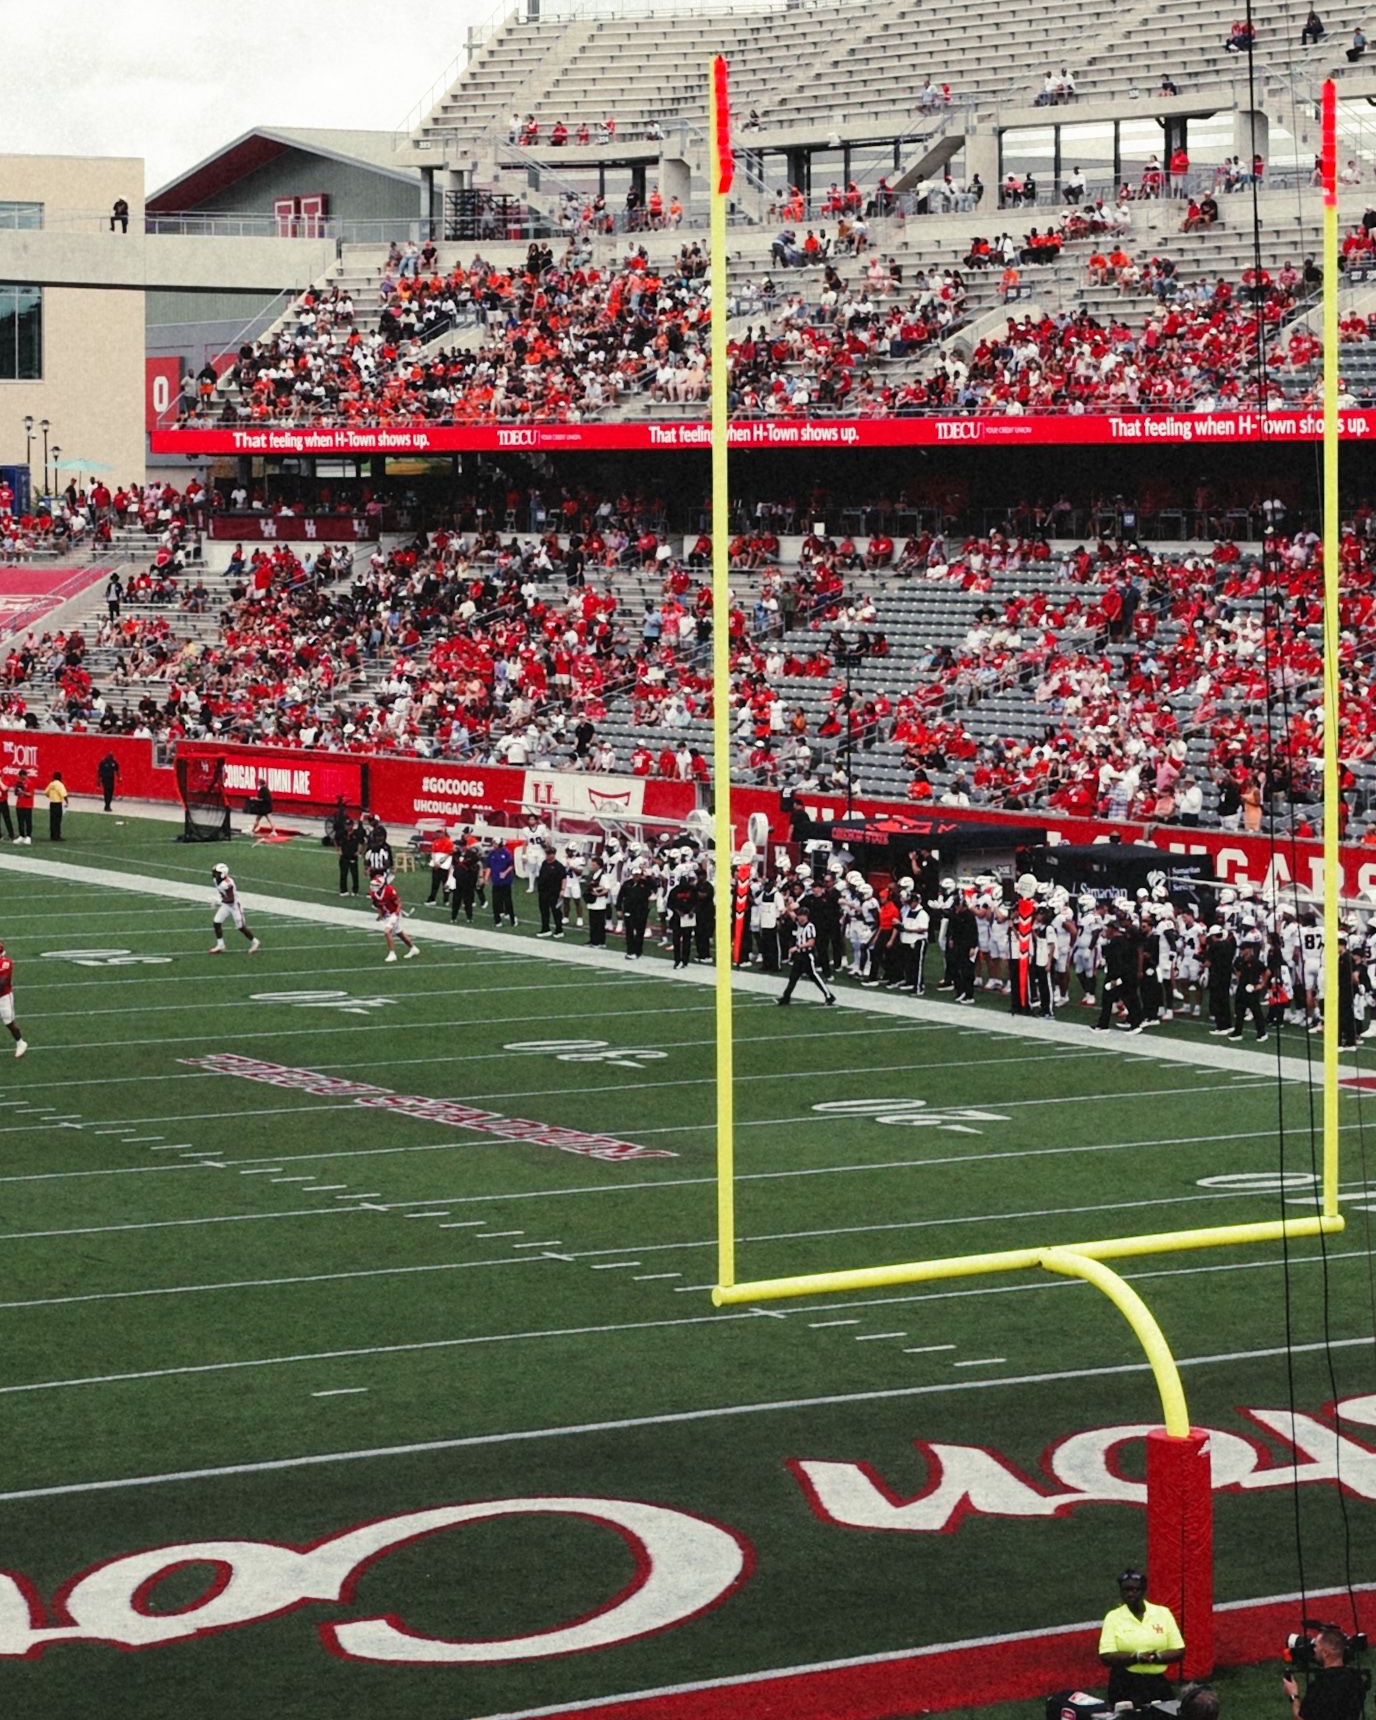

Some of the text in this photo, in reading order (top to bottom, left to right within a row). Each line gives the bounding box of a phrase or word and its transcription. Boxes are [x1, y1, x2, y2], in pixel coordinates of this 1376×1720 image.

[497, 430, 538, 445] TDECU
[648, 424, 859, 444] That feelin H-Town shows up.
[935, 422, 983, 439] TDECU
[1109, 417, 1142, 437] That
[1143, 416, 1192, 440] feeling
[1195, 418, 1233, 436] when
[1299, 415, 1344, 434] shos
[1348, 416, 1370, 437] up.
[233, 430, 430, 451] That feeling when H-Town shows up.
[293, 769, 311, 795] ARE
[422, 776, 484, 797] #GOCOOGS
